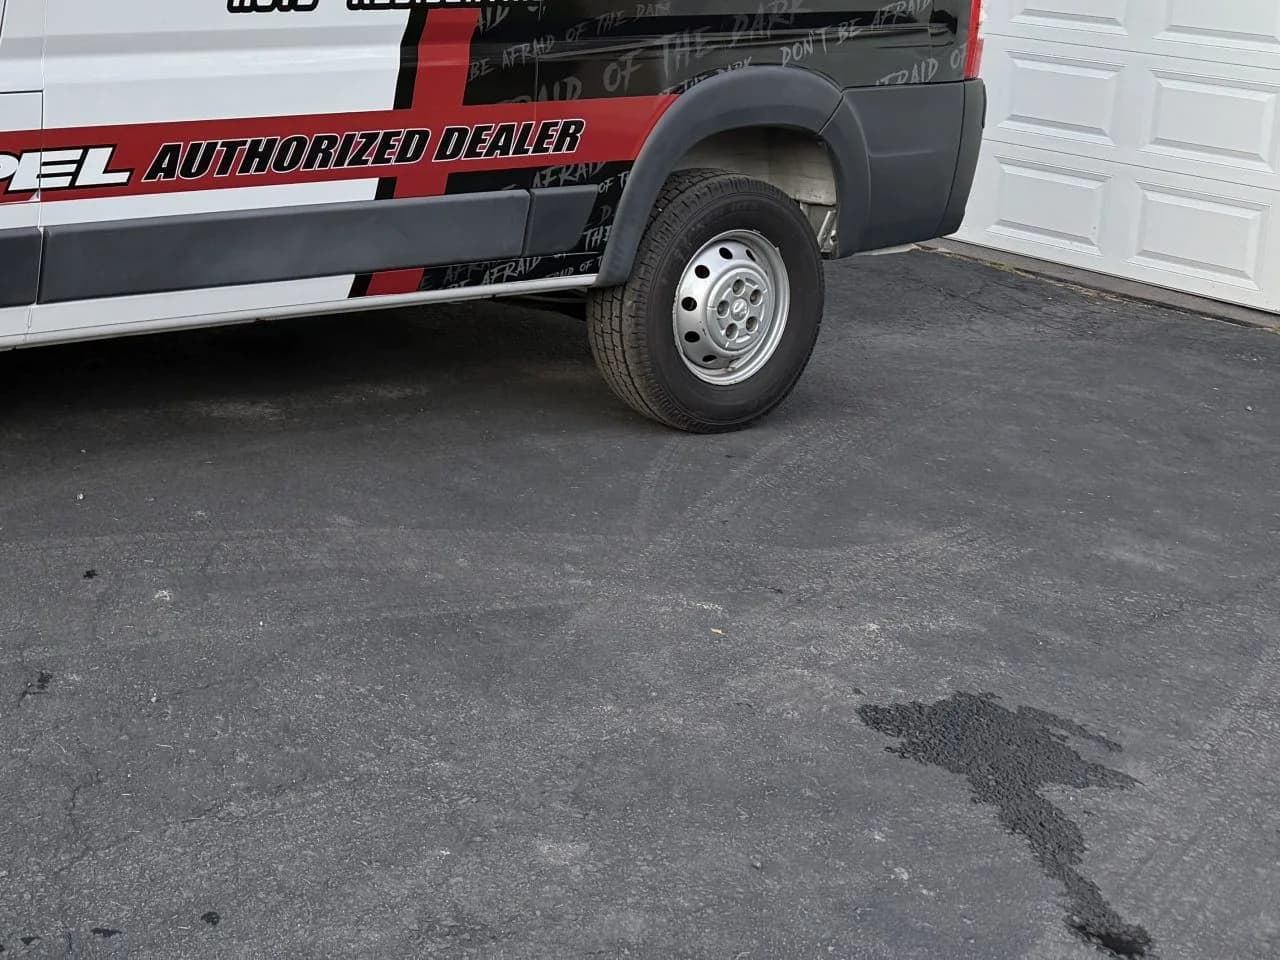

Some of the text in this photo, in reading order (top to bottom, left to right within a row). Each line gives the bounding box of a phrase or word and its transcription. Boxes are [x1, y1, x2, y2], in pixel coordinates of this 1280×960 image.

[565, 23, 587, 43] OF
[595, 11, 634, 35] THE
[141, 128, 432, 183] AUTHORIZED
[432, 118, 587, 163] DEALER
